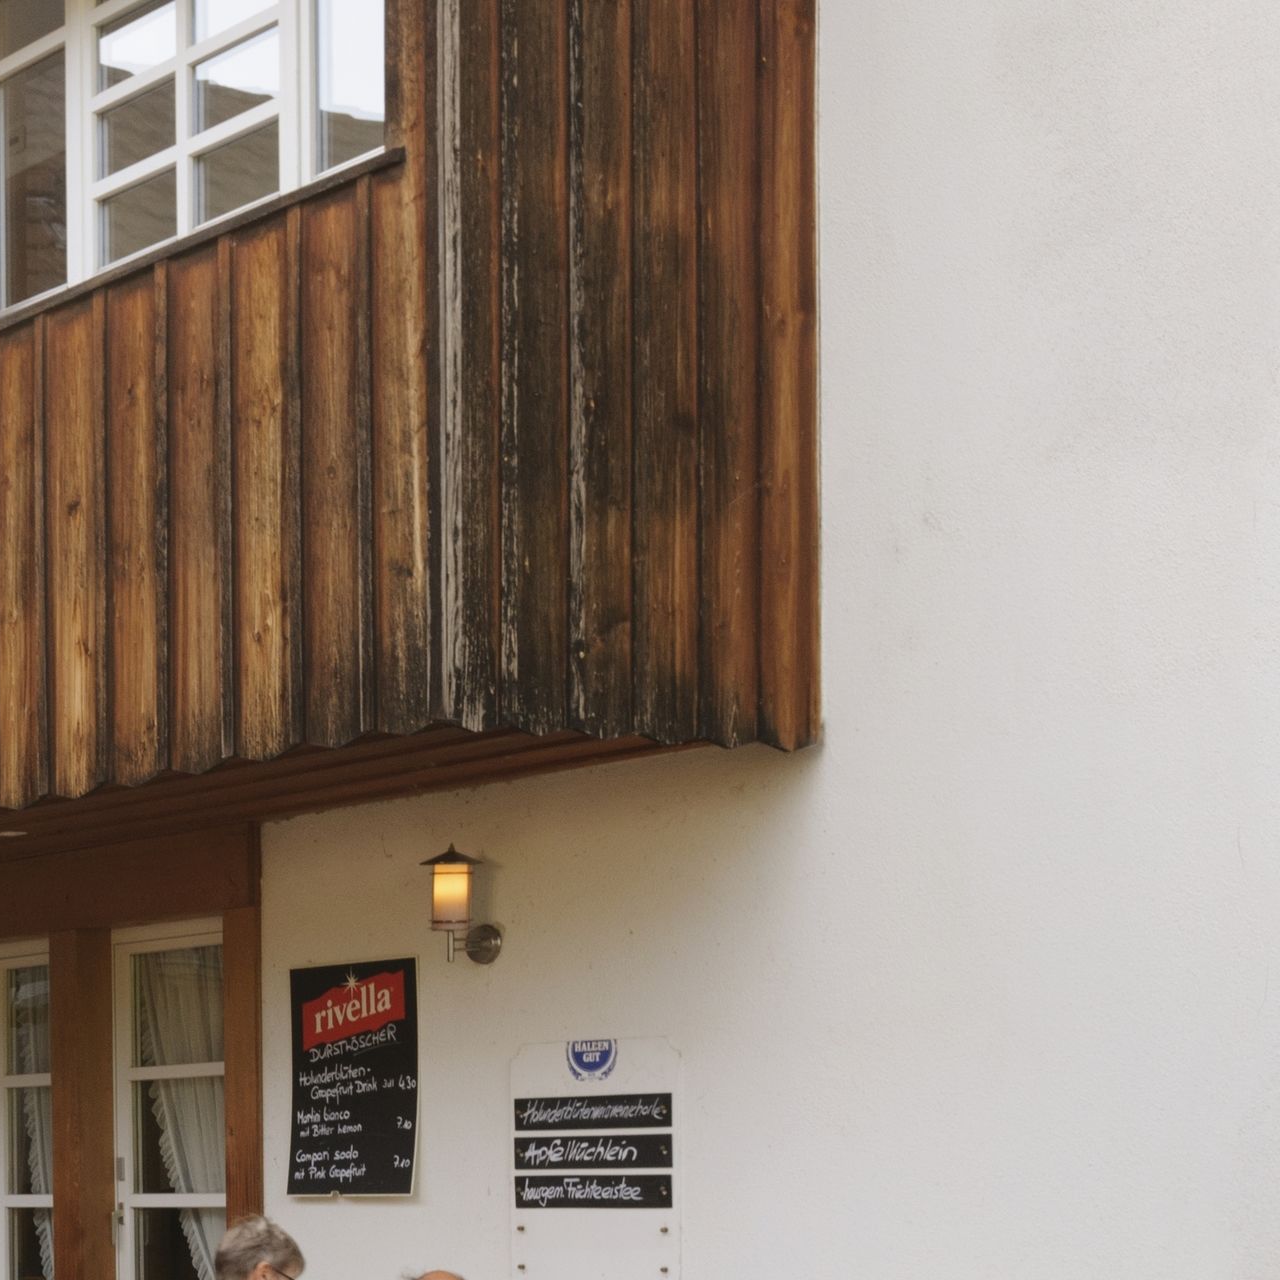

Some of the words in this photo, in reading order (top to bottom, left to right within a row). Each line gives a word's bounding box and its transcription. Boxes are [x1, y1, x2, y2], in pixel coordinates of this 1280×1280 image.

[314, 982, 391, 1034] rivella
[309, 1023, 397, 1062] DURSTLÖSCHER
[582, 1052, 601, 1063] GUT
[311, 1083, 353, 1104] Grapefruit
[355, 1076, 377, 1099] Drink
[296, 1107, 321, 1125] Martini
[324, 1106, 350, 1121] bianco
[312, 1124, 334, 1138] Bitter
[296, 1146, 331, 1168] Campari
[525, 1138, 638, 1166] Apfelküchlein
[294, 1168, 305, 1180] mit
[308, 1166, 326, 1180] Pink
[329, 1162, 367, 1183] Grapefruit
